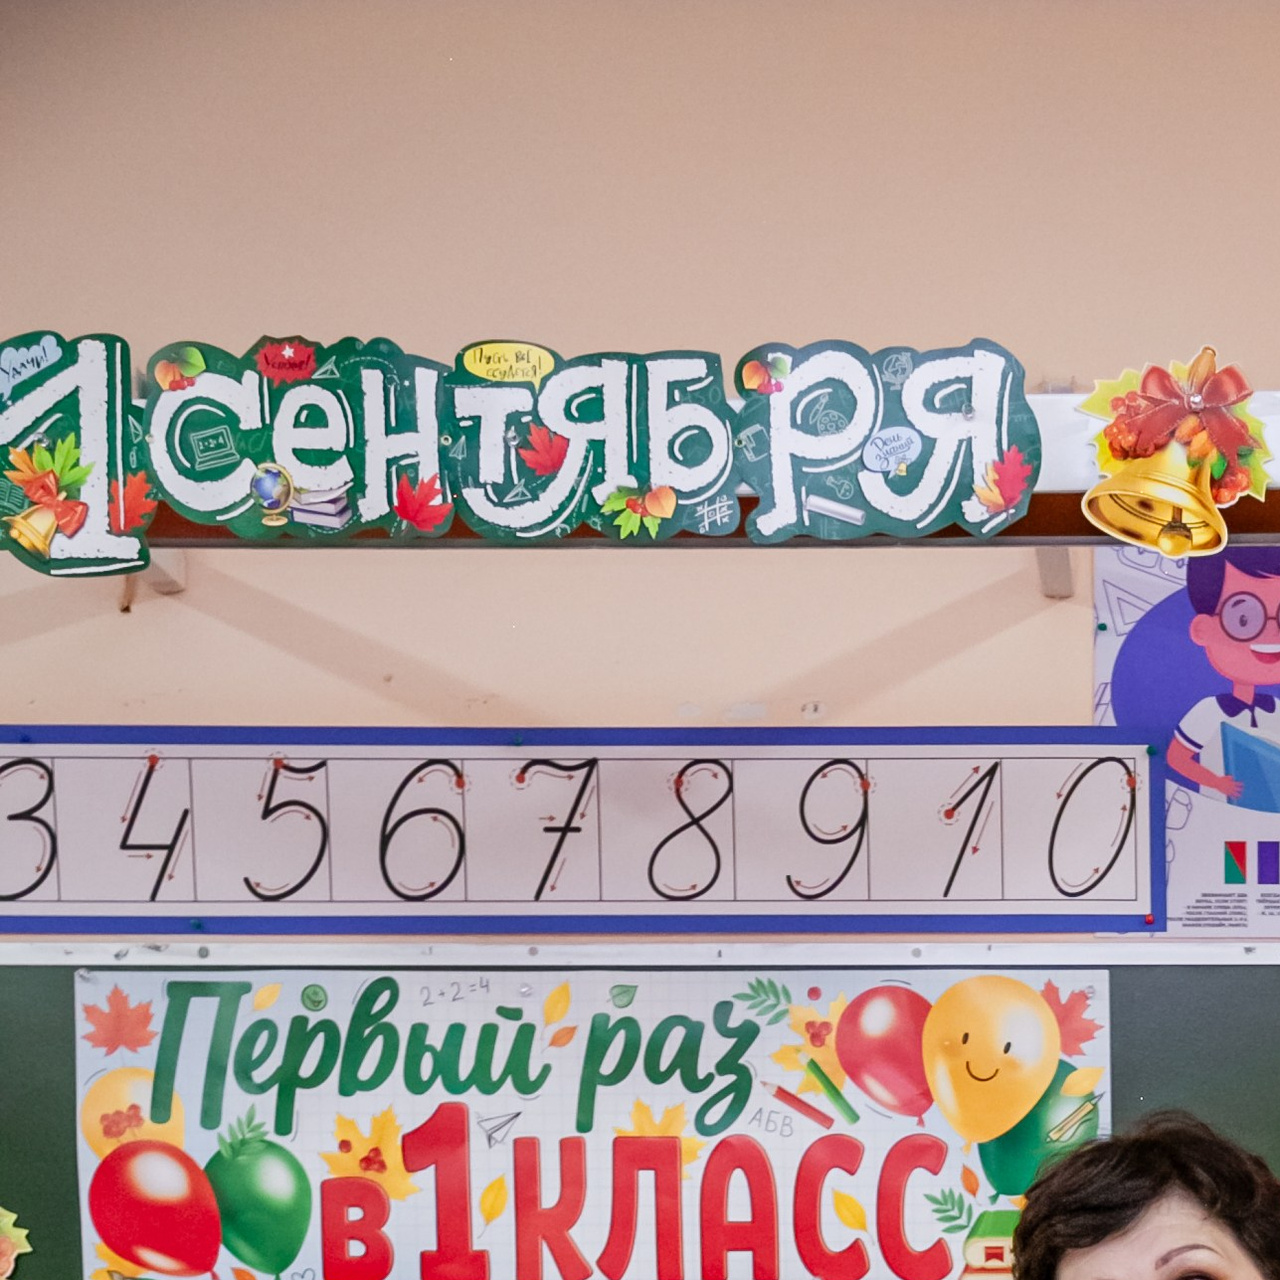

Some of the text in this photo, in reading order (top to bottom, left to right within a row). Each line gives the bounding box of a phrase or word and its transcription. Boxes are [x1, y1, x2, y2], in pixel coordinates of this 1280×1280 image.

[150, 976, 756, 1136] Первый раз
[748, 1106, 795, 1139] АБВ
